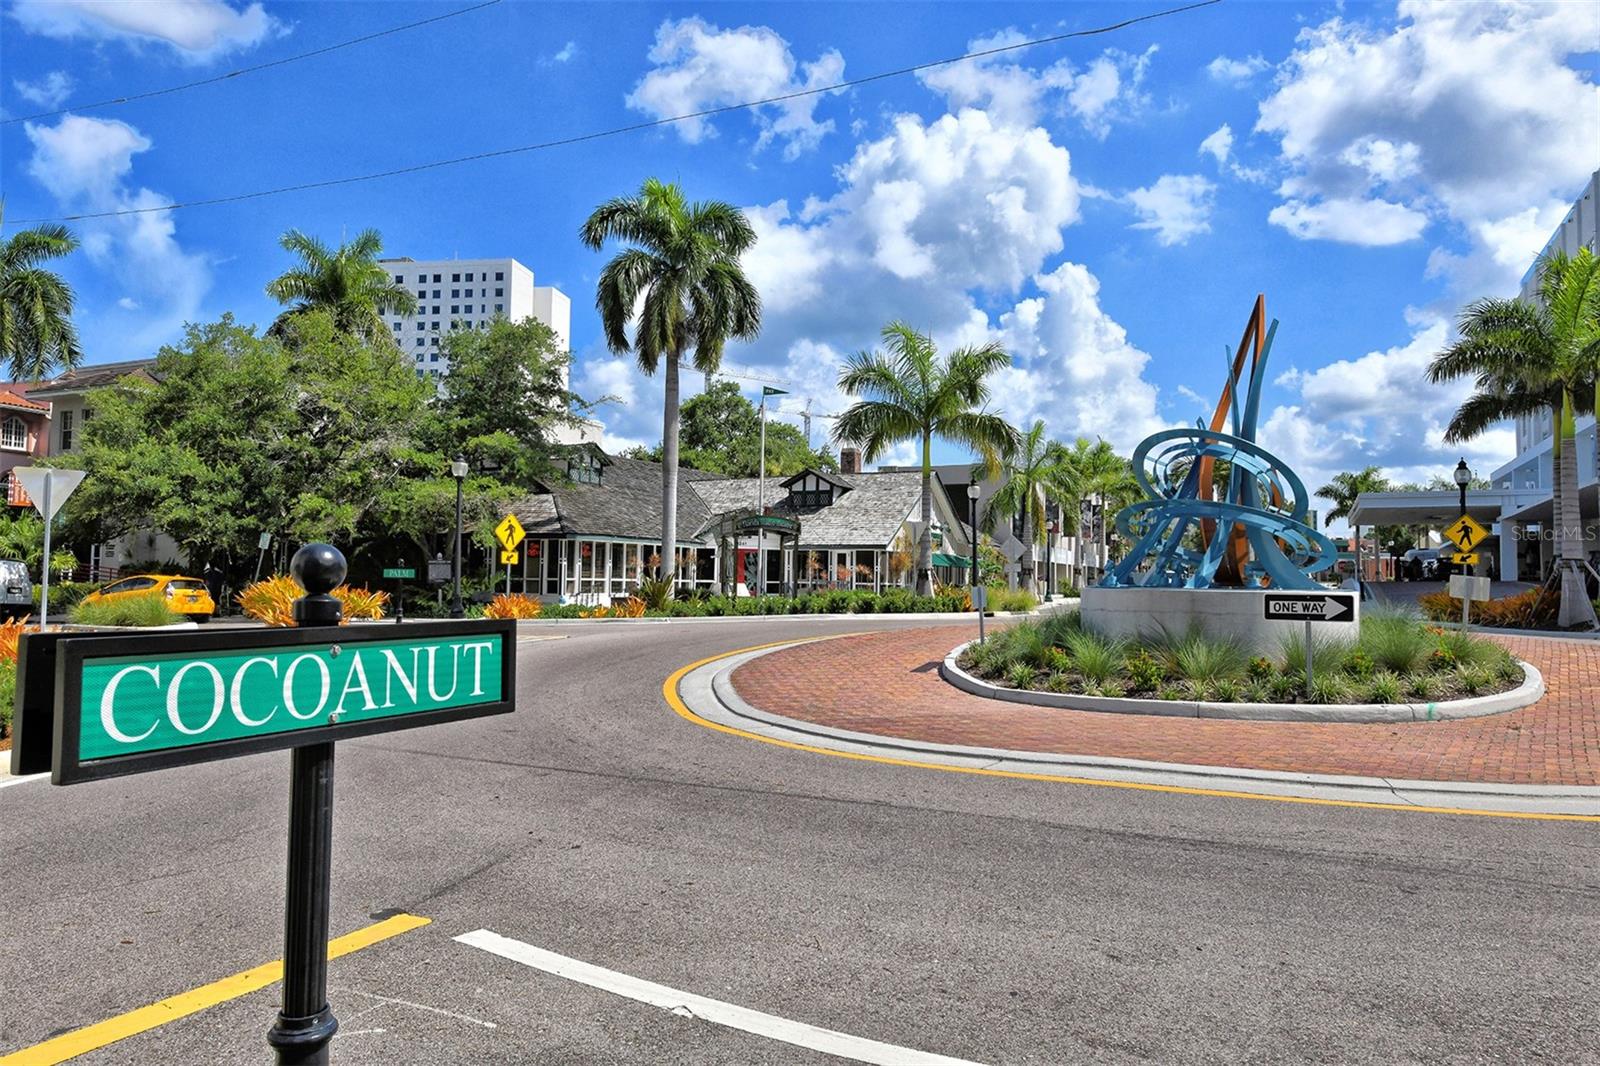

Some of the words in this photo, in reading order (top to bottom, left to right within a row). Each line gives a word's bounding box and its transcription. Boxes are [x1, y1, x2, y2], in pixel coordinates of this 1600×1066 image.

[389, 569, 410, 578] PALM
[1273, 602, 1298, 613] ONE
[1301, 602, 1326, 613] WAY
[100, 641, 494, 743] COCOANUT
